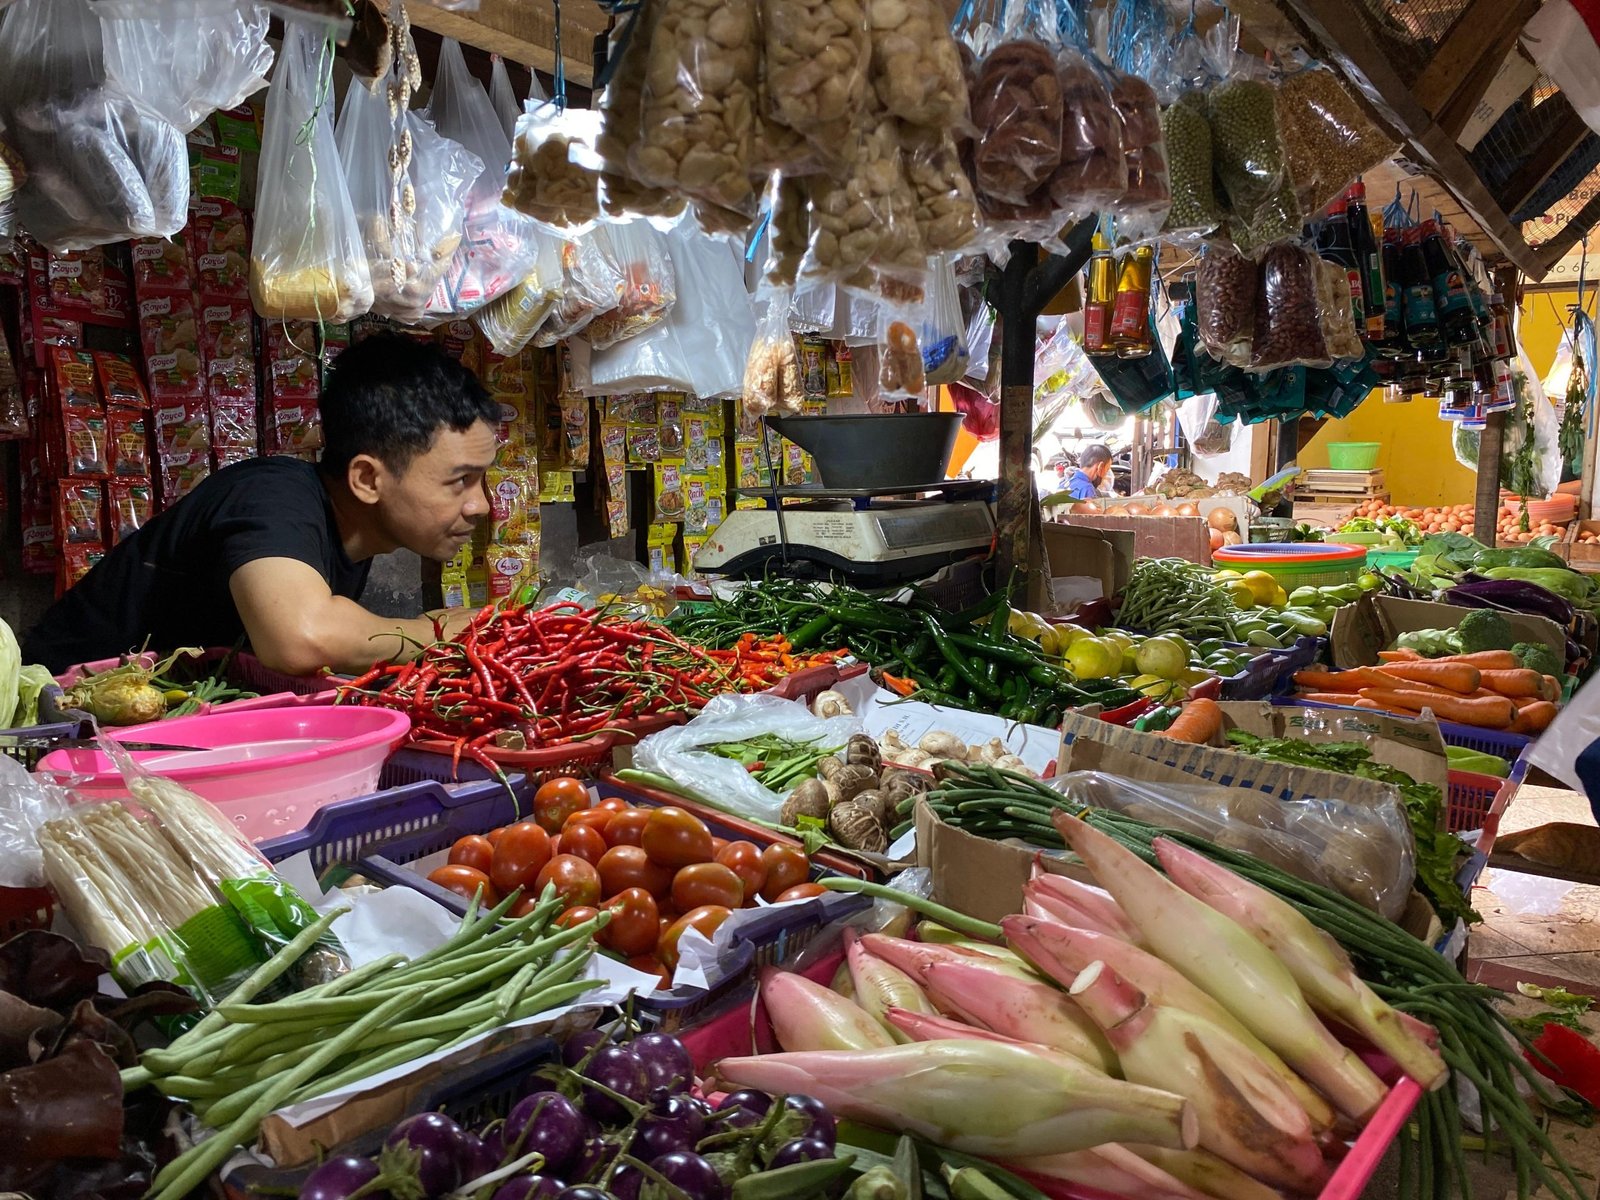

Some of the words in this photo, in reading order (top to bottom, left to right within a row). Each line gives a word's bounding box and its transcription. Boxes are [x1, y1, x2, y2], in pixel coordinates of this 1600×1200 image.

[136, 247, 161, 257] Royco
[202, 256, 225, 267] Royco
[52, 264, 79, 275] Royco
[142, 303, 168, 314] Royco
[206, 309, 230, 319] Royco
[452, 323, 472, 336] Sasa
[150, 358, 176, 368] Royco
[273, 362, 296, 371] Royco
[159, 411, 183, 421] Royco
[277, 411, 299, 421] Royco
[162, 453, 188, 465] Royco
[662, 470, 680, 485] Racik
[499, 484, 518, 496] Sasa
[688, 488, 706, 502] Racik
[500, 561, 519, 571] Sasa
